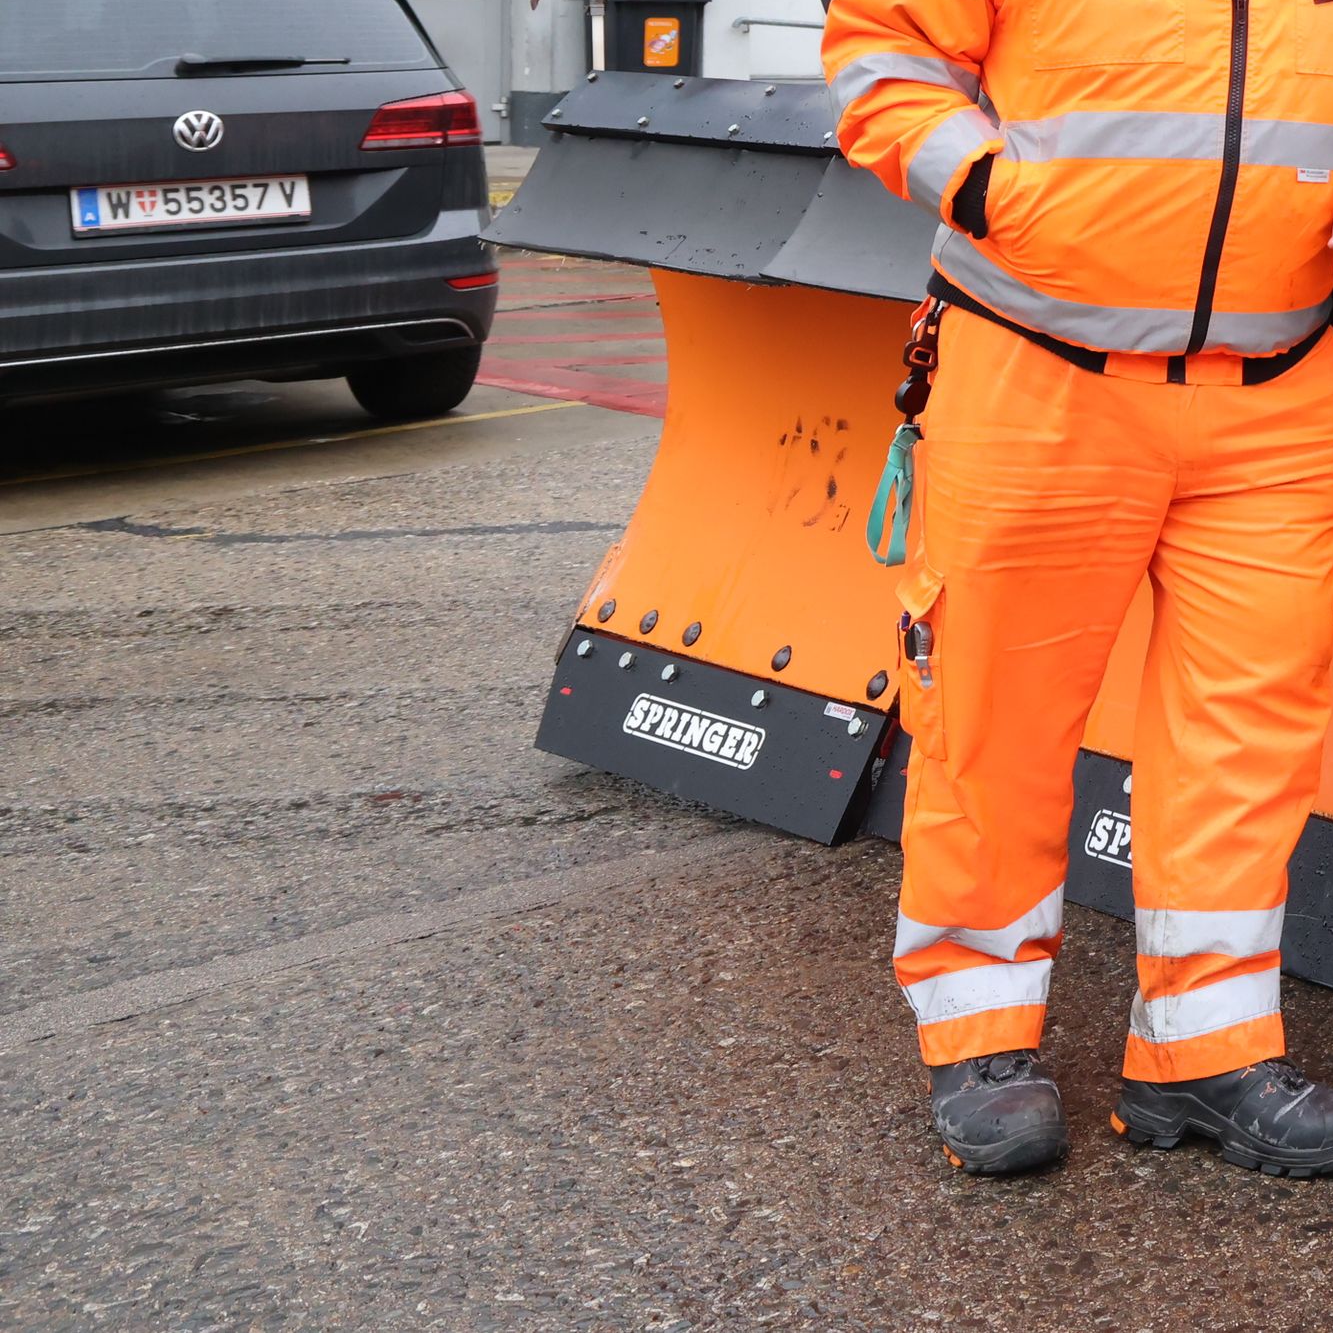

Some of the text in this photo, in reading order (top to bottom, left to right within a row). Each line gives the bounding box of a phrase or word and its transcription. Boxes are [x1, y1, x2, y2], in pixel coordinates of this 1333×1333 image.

[106, 190, 131, 220] W
[162, 183, 270, 216] 55357
[279, 180, 296, 208] V
[626, 698, 760, 765] SPRINGER
[1089, 816, 1132, 860] SP
